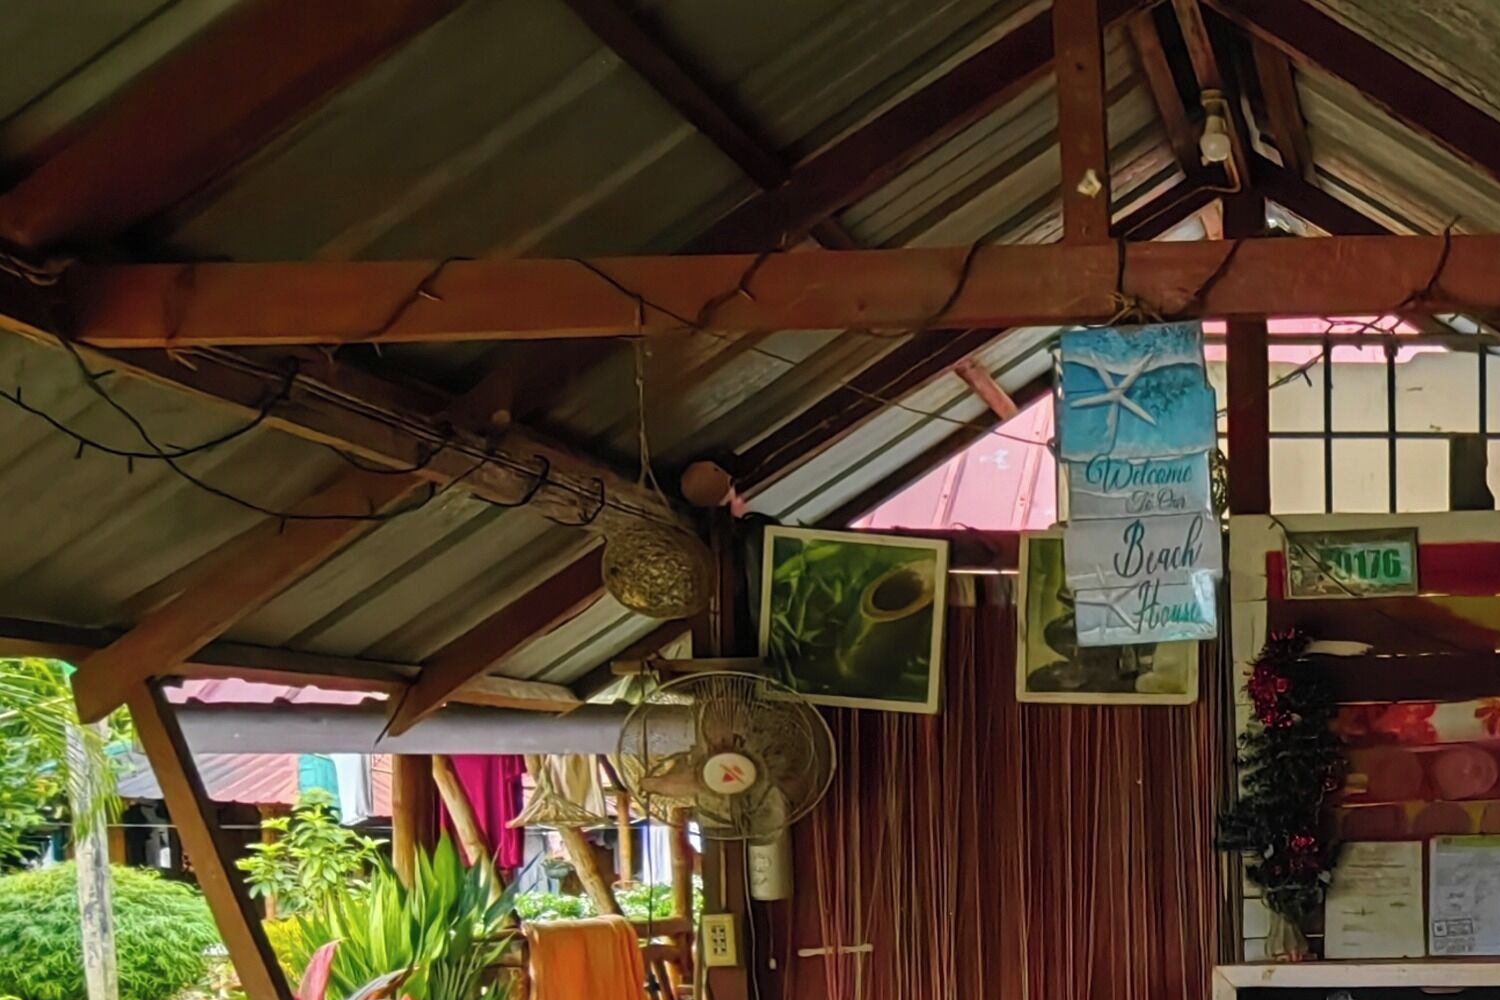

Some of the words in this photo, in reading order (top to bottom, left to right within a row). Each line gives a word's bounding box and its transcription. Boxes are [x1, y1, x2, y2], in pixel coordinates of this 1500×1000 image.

[1085, 453, 1192, 491] Welcome
[1157, 488, 1187, 511] Our
[1113, 515, 1204, 579] Beach
[1133, 579, 1200, 633] House
